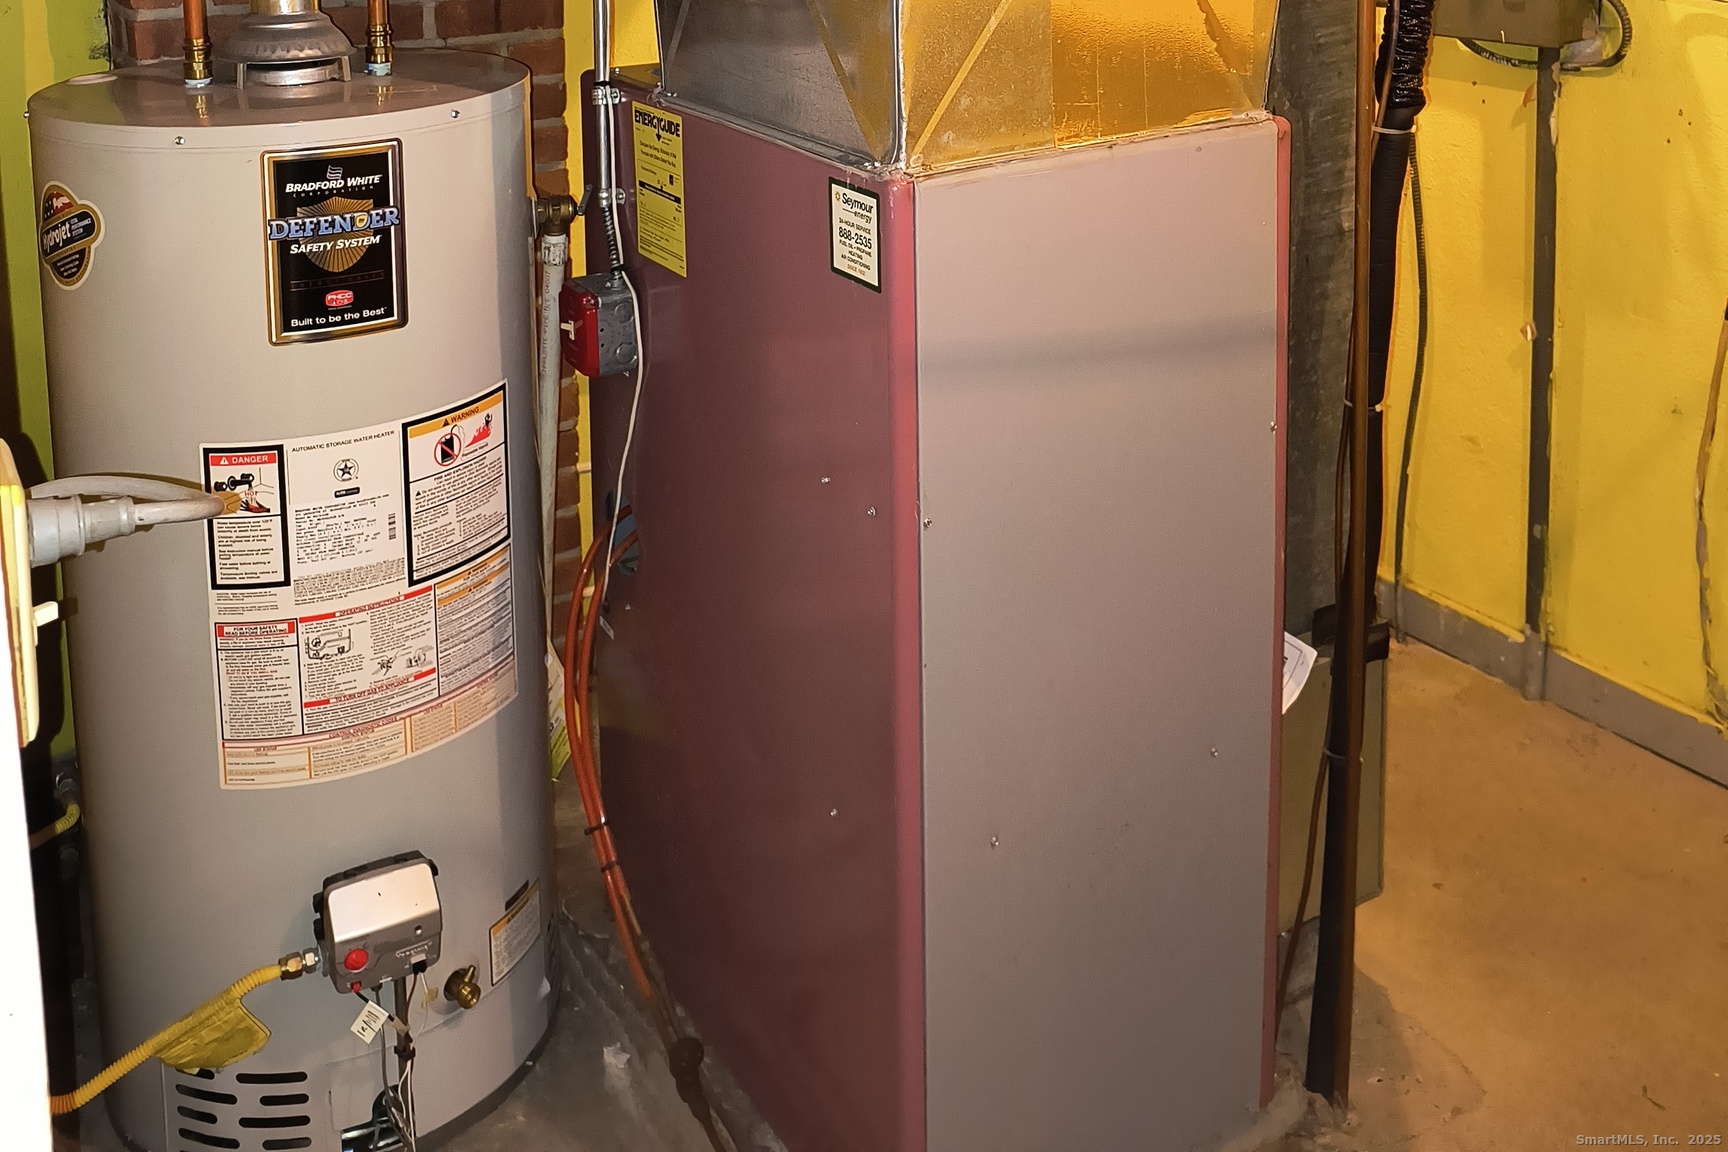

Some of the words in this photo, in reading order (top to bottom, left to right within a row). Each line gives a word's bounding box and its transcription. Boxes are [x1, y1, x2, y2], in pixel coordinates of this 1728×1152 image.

[634, 109, 680, 138] ENERGYGUIDE
[285, 179, 345, 193] BRADFORD
[346, 175, 381, 187] WHITE
[292, 185, 374, 198] CORPORATION
[841, 192, 874, 214] Seymour
[269, 207, 400, 240] DEFENDER
[853, 210, 873, 224] energy
[290, 241, 335, 255] SAFETY
[335, 235, 381, 249] SYSTEM
[838, 226, 873, 250] 888-2535
[290, 318, 314, 327] Built
[315, 317, 326, 325] to
[328, 314, 342, 323] be
[344, 311, 360, 320] the
[362, 307, 385, 317] Best
[450, 406, 480, 424] WARNING
[291, 443, 325, 453] AUTOMATIC
[325, 439, 352, 448] STORAGE
[353, 434, 373, 444] WATER
[373, 430, 395, 439] HEATER
[231, 455, 269, 464] DANGER
